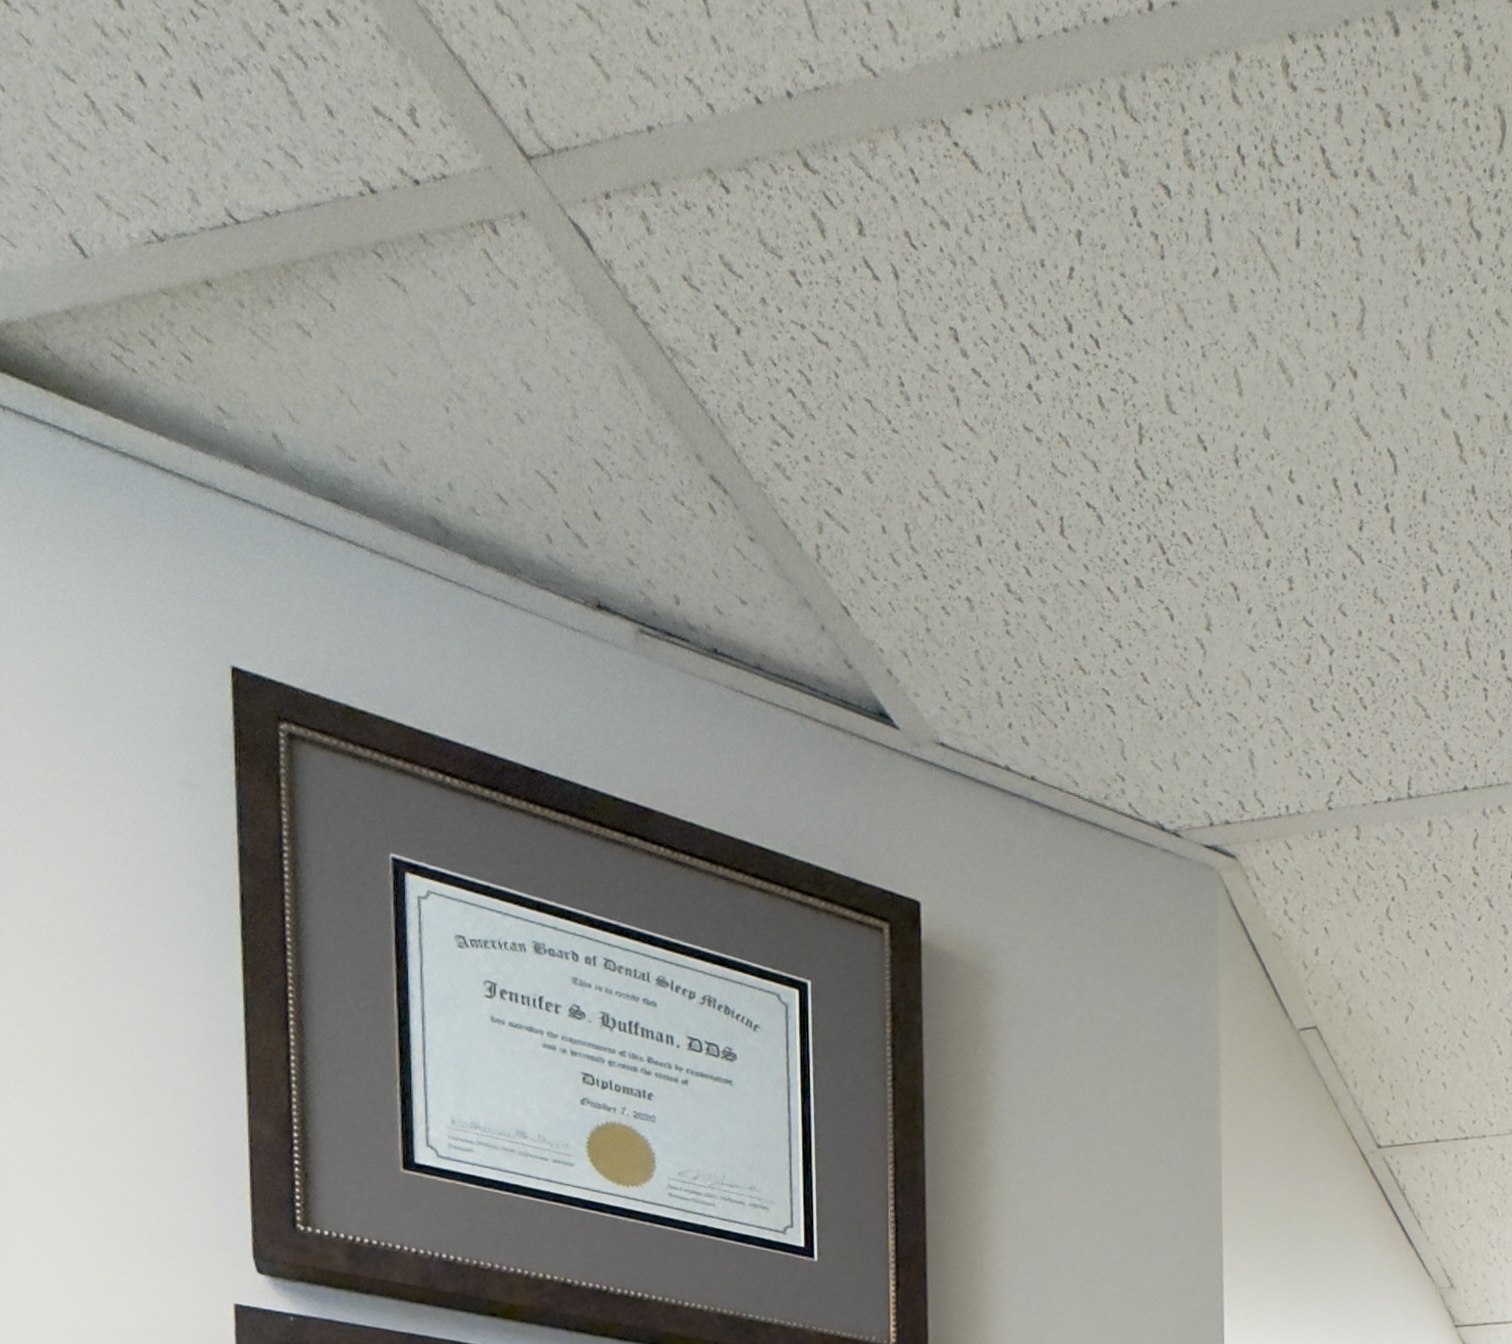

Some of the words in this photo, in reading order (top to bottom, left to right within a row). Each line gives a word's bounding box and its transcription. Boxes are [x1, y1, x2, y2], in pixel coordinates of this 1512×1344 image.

[454, 933, 527, 953] American
[532, 940, 580, 962] Board
[584, 955, 597, 966] of
[603, 957, 651, 984] Dental
[655, 975, 696, 1000] Sleep
[700, 994, 762, 1033] Medicine
[483, 979, 562, 1014] Jennifer
[686, 1035, 738, 1062] DDS
[580, 1071, 654, 1101] Diplomate
